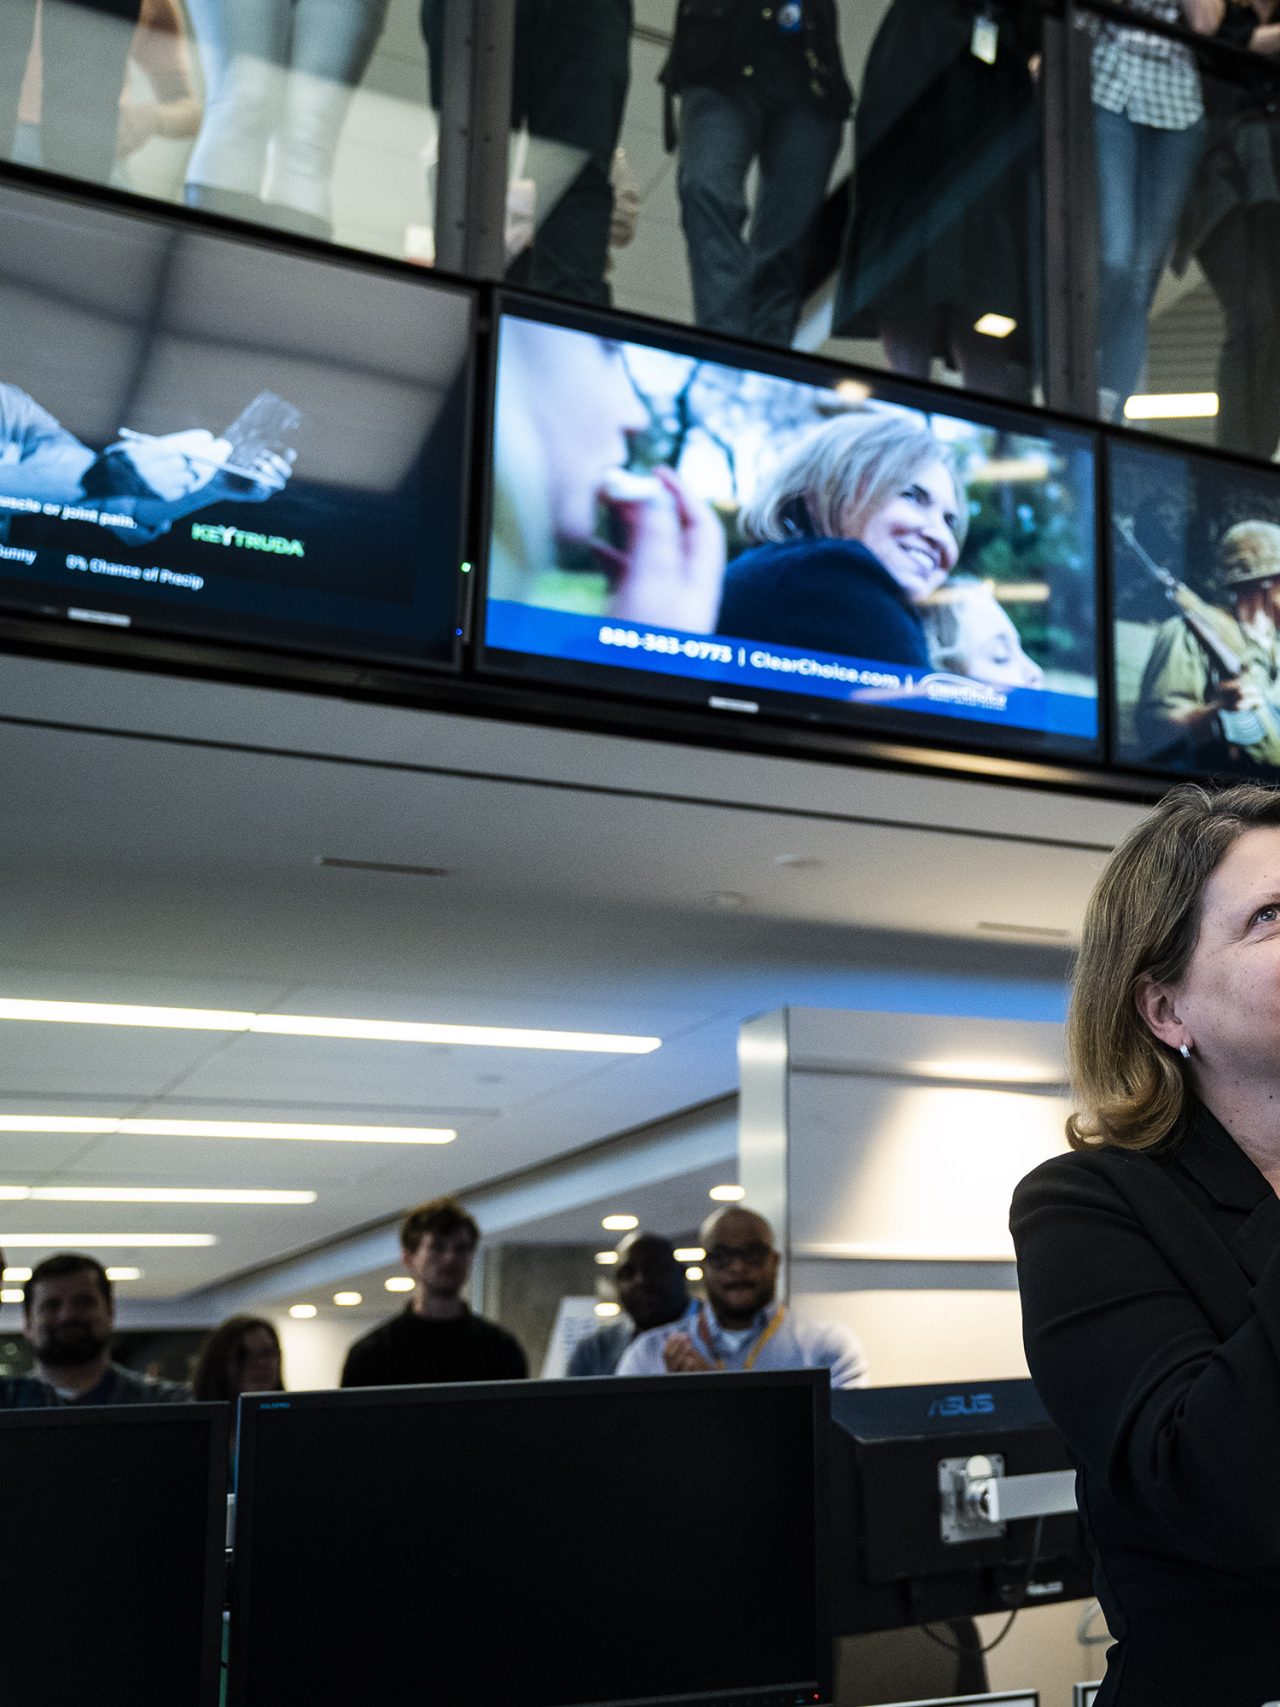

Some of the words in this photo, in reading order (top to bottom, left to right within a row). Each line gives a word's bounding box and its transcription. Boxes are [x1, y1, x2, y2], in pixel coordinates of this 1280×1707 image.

[0, 495, 41, 513] uscle
[61, 503, 98, 523] joint
[191, 522, 305, 557] KEYTRUDA
[89, 558, 142, 580] Chance
[142, 567, 159, 582] of
[160, 568, 204, 590] Precip
[750, 650, 900, 690] ClearChoice.com
[928, 1393, 995, 1417] ASUS
